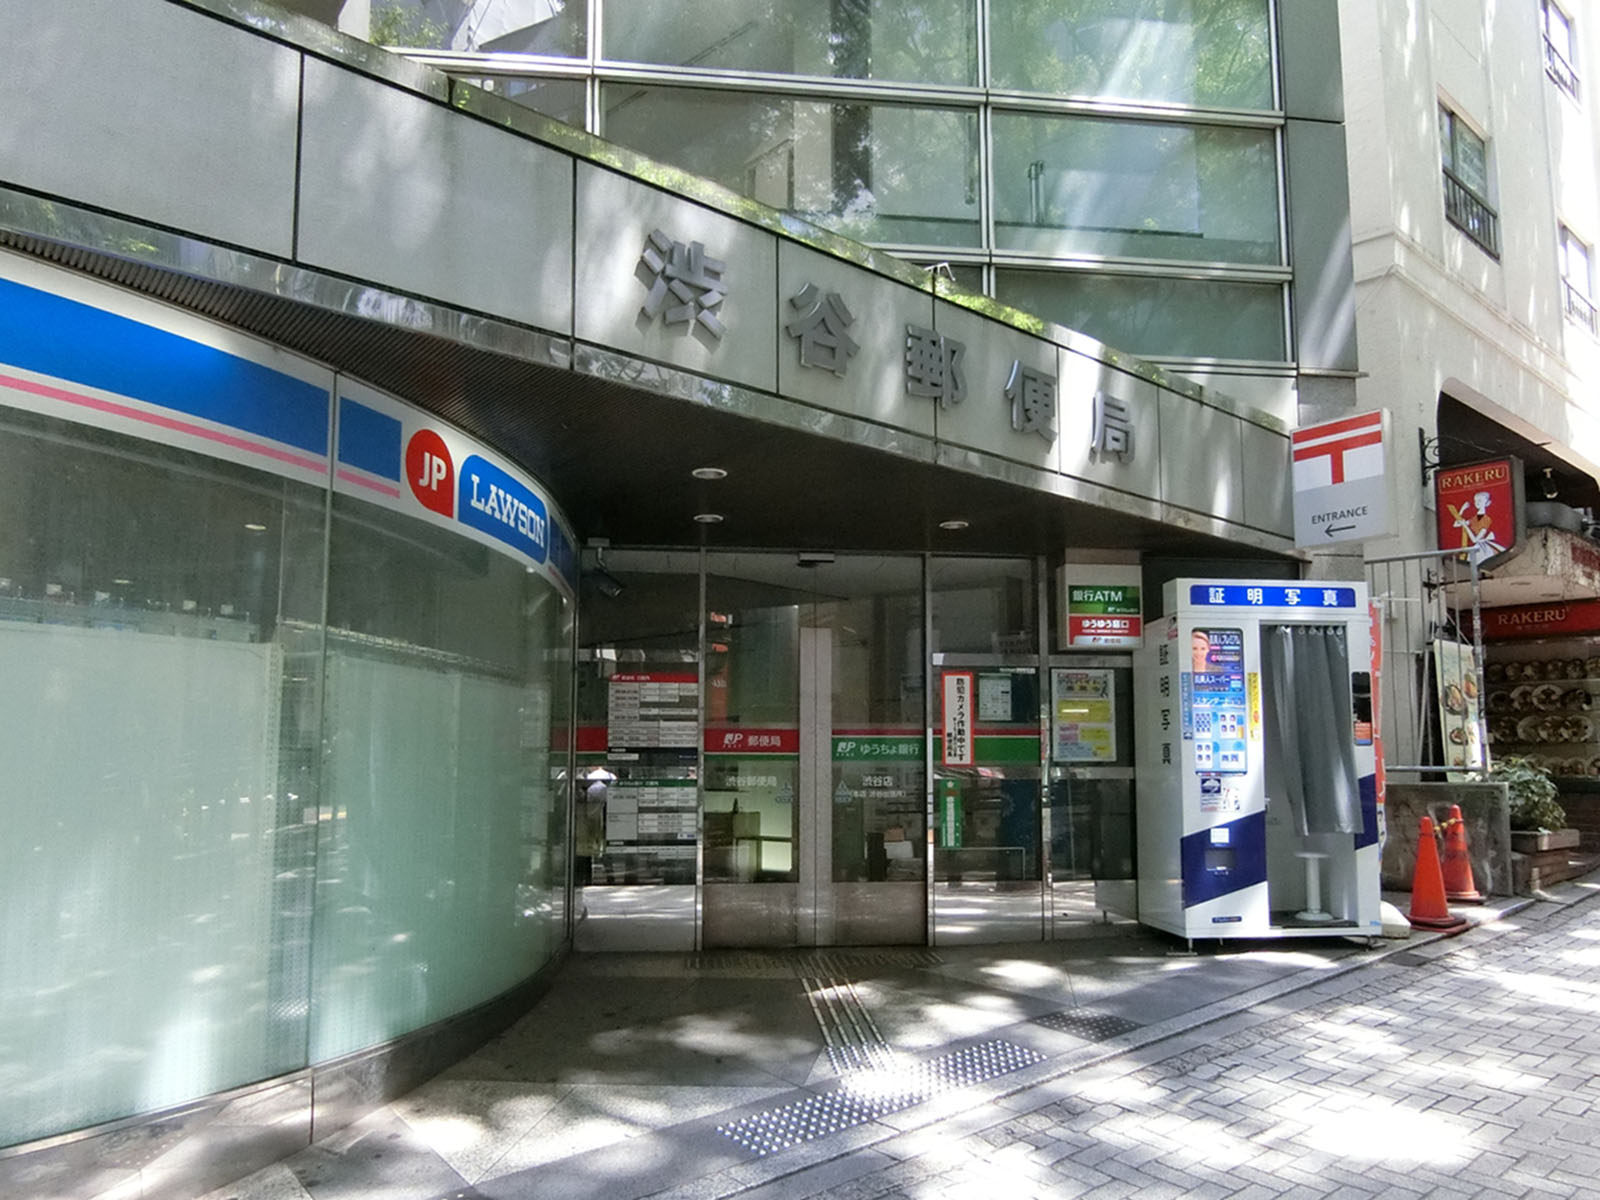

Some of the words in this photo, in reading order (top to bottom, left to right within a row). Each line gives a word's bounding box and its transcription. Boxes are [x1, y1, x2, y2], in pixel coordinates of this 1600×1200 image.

[636, 228, 1135, 465] 渋谷郵便局
[419, 451, 447, 491] JP
[1441, 467, 1506, 489] RAKERU
[470, 473, 546, 548] LAWSON
[1311, 505, 1369, 525] ENTRANCE
[1072, 590, 1123, 602] 銀行ATM
[1208, 587, 1339, 606] 証明写真
[1498, 608, 1567, 625] RAKERU
[748, 735, 782, 747] 郵便局
[860, 743, 920, 756] ゆうちょ銀行
